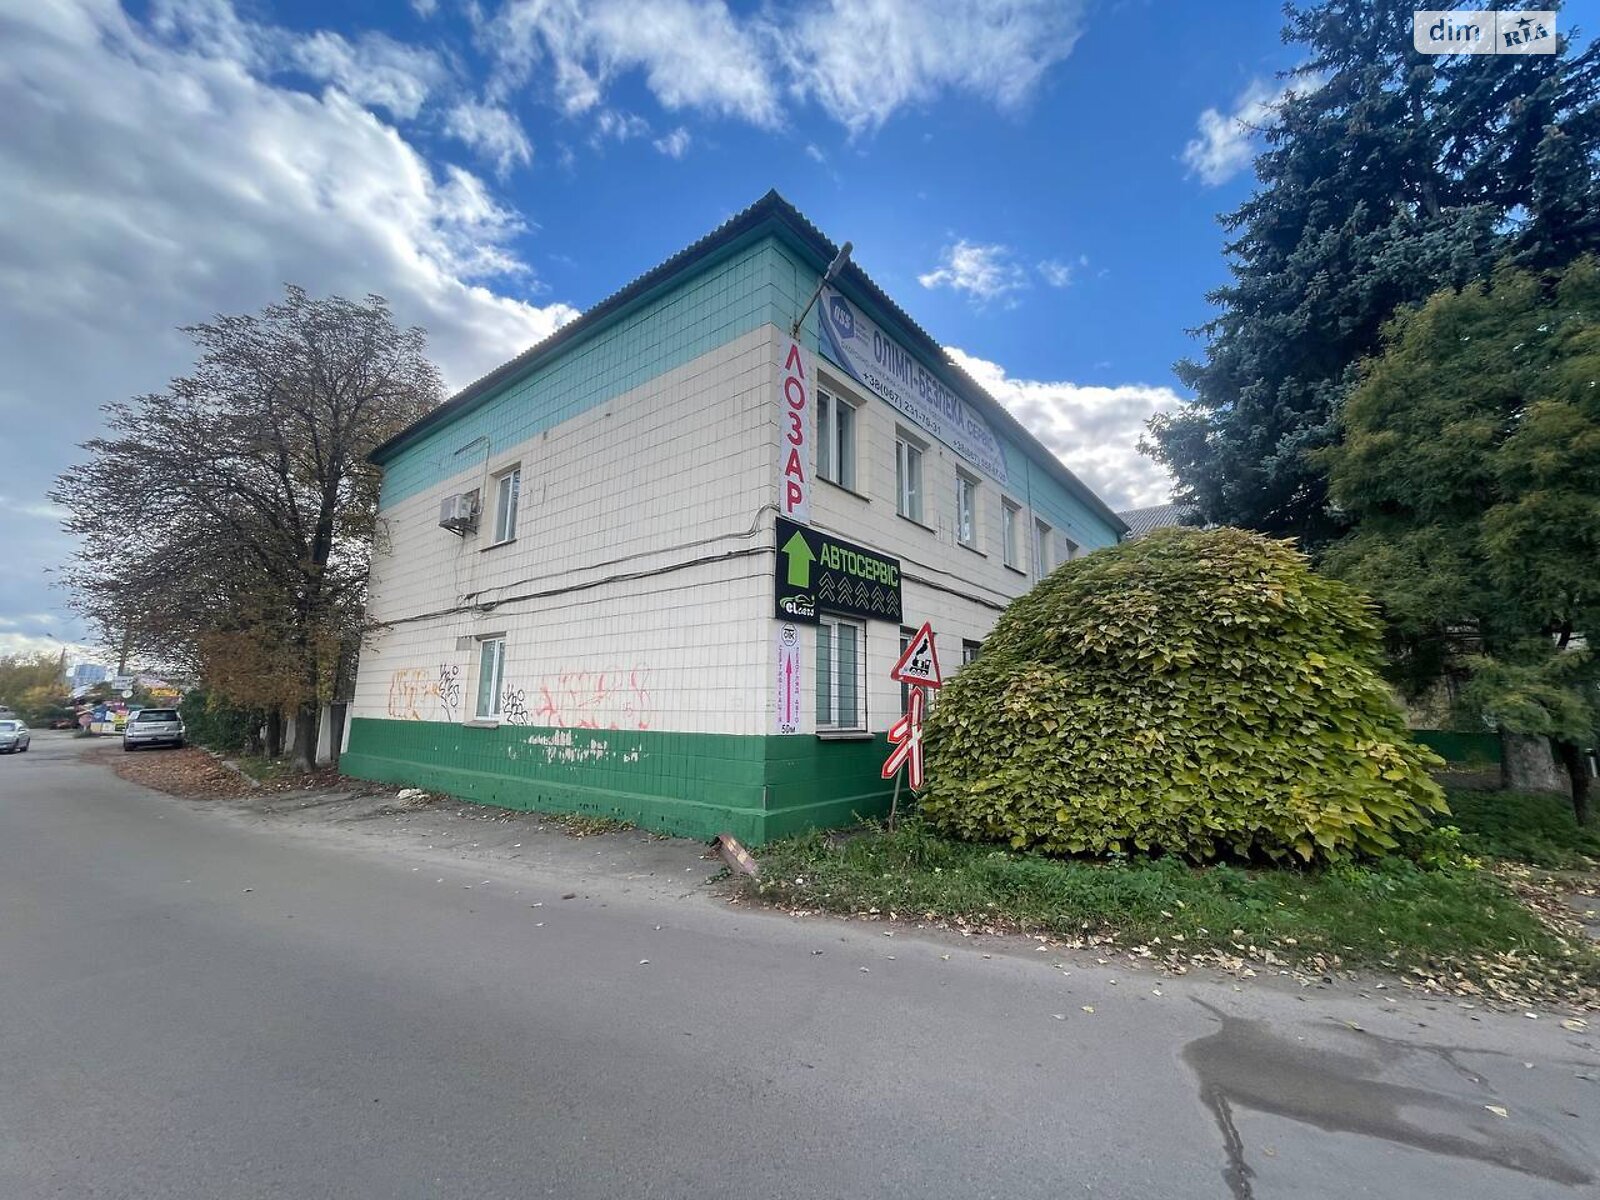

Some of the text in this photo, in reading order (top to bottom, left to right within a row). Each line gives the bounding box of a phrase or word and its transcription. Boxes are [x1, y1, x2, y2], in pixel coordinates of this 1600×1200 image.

[784, 343, 806, 514] ЛОЗАР
[873, 329, 966, 431] ОЛІМП-БЕЗПЕКА
[820, 542, 899, 588] АВТОСЕРВІС
